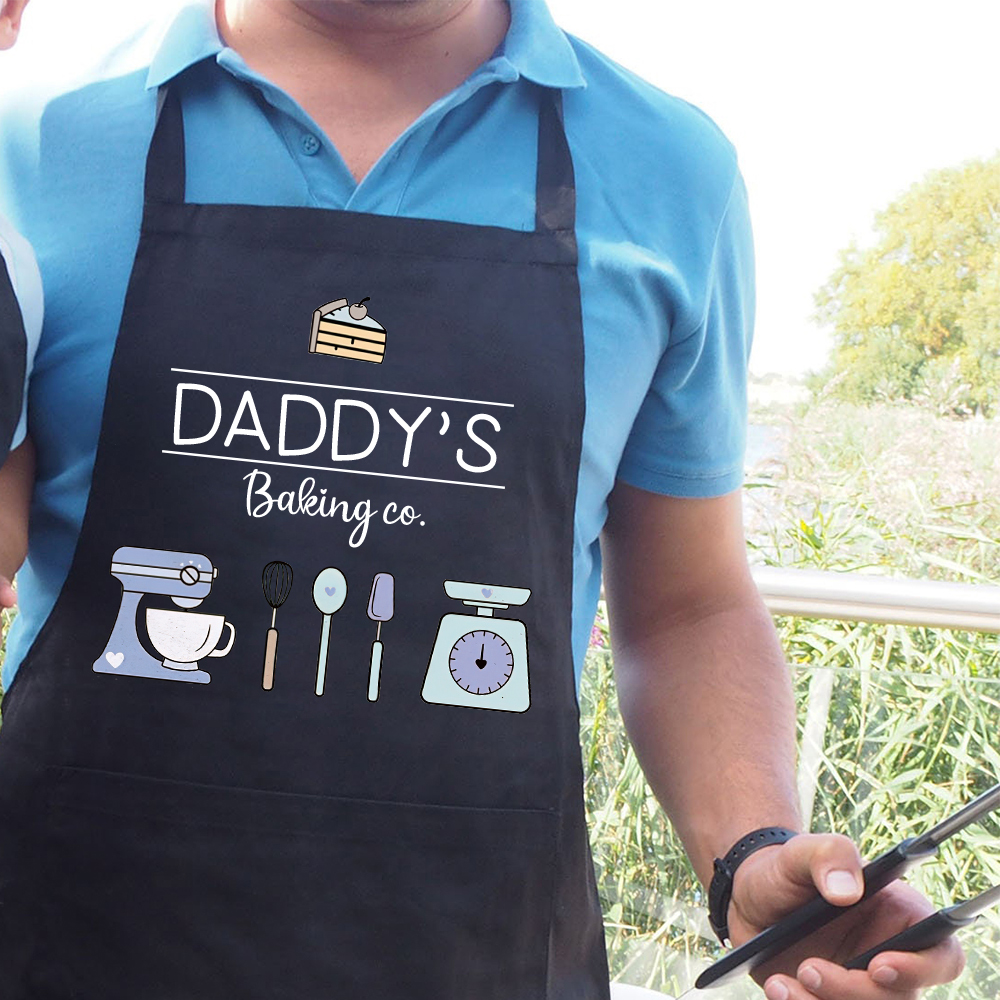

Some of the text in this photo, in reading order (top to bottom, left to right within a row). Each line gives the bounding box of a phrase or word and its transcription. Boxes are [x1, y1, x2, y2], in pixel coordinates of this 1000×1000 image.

[173, 382, 502, 474] DADDY'S
[242, 468, 427, 549] Baking co.
